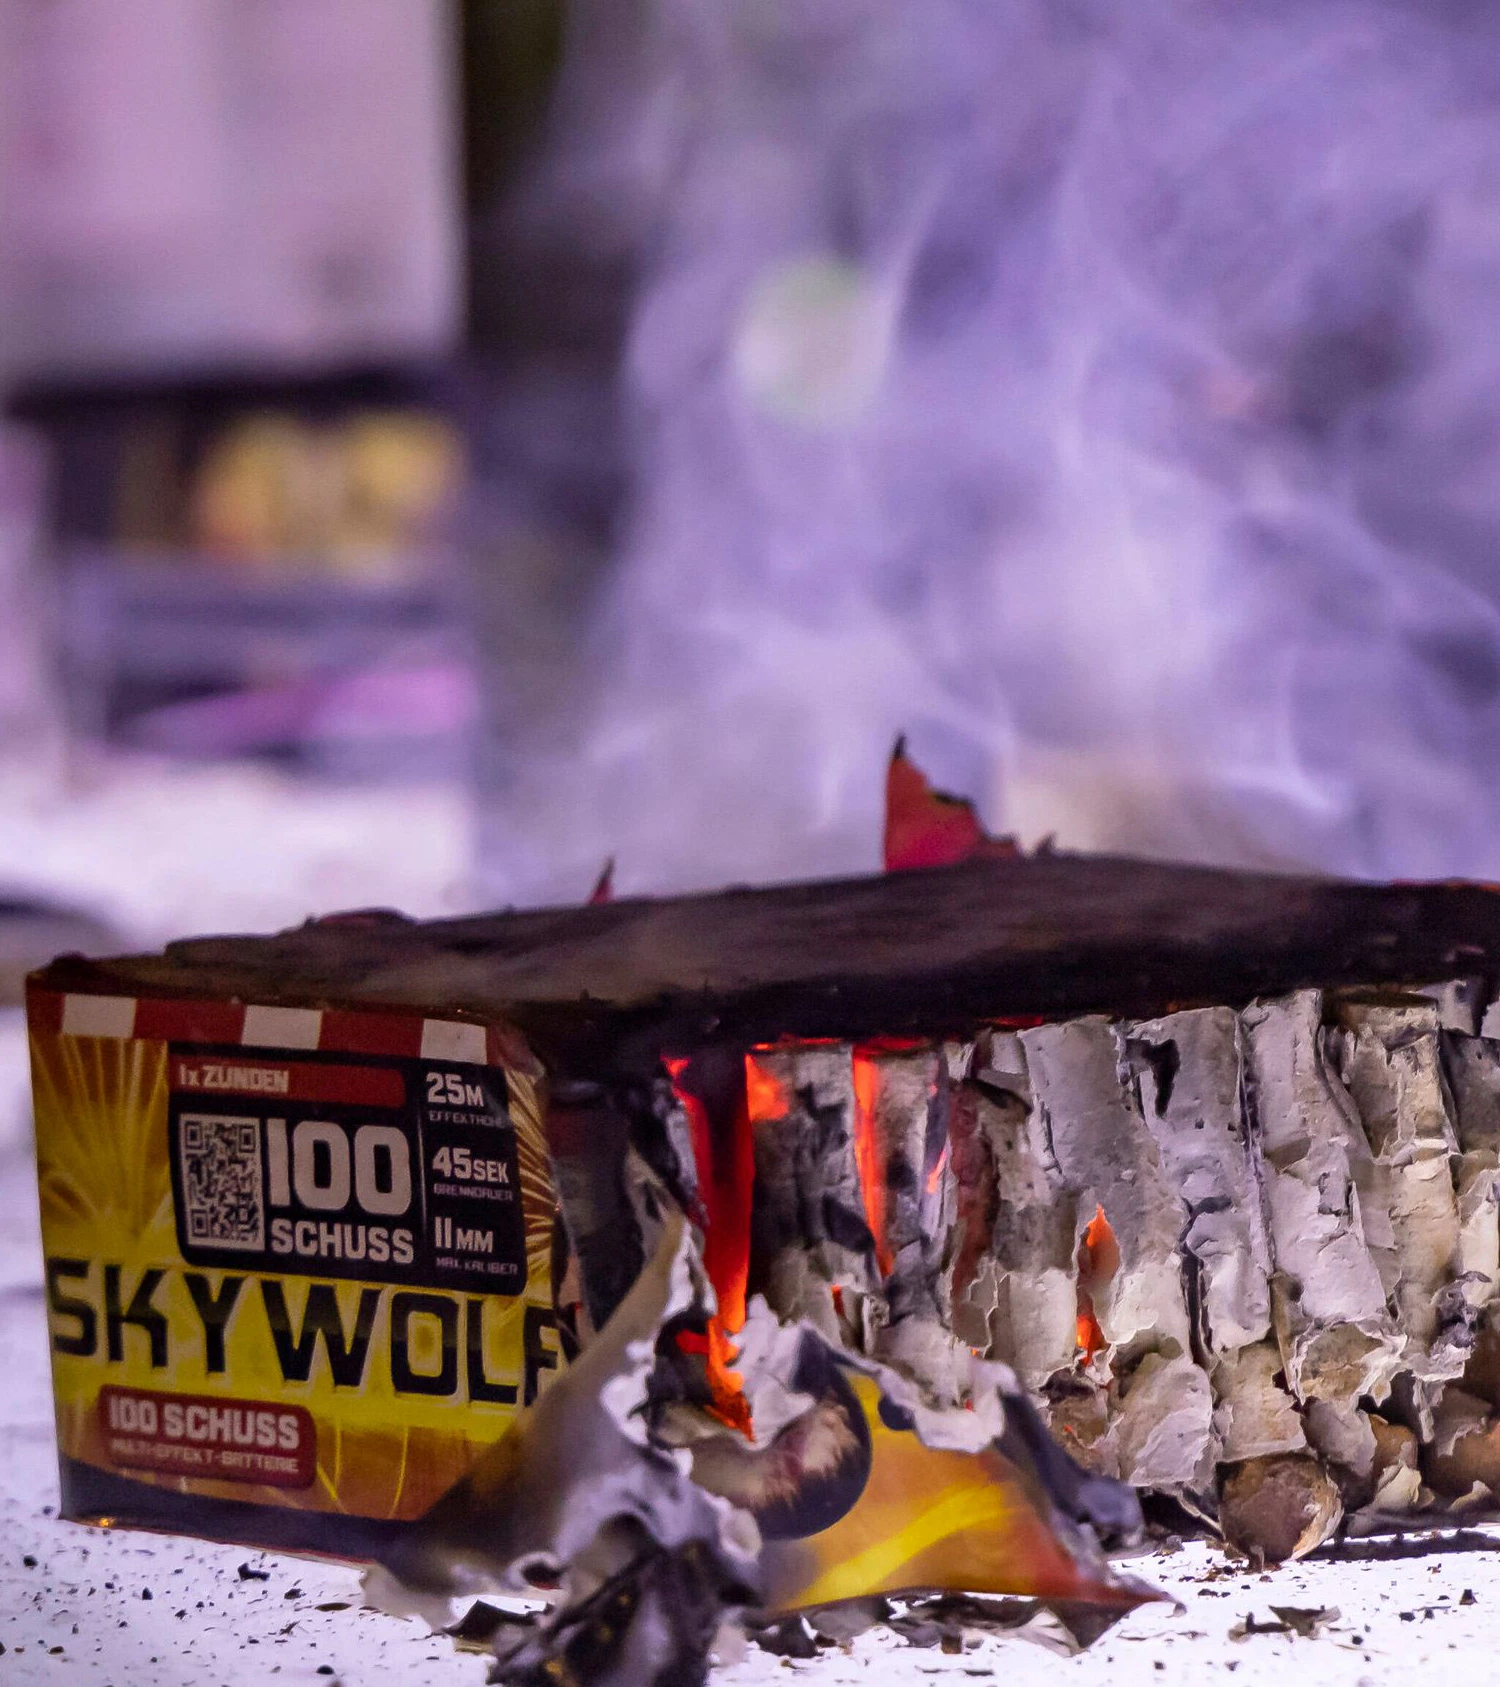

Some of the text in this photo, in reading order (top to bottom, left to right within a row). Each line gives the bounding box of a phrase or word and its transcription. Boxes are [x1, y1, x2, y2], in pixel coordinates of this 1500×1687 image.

[266, 1118, 412, 1216] 100
[270, 1218, 414, 1264] SCHUSS
[464, 1261, 518, 1275] KALIBER
[47, 1257, 576, 1407] SKYWOLF
[109, 1395, 300, 1450] 100 SCHUSS
